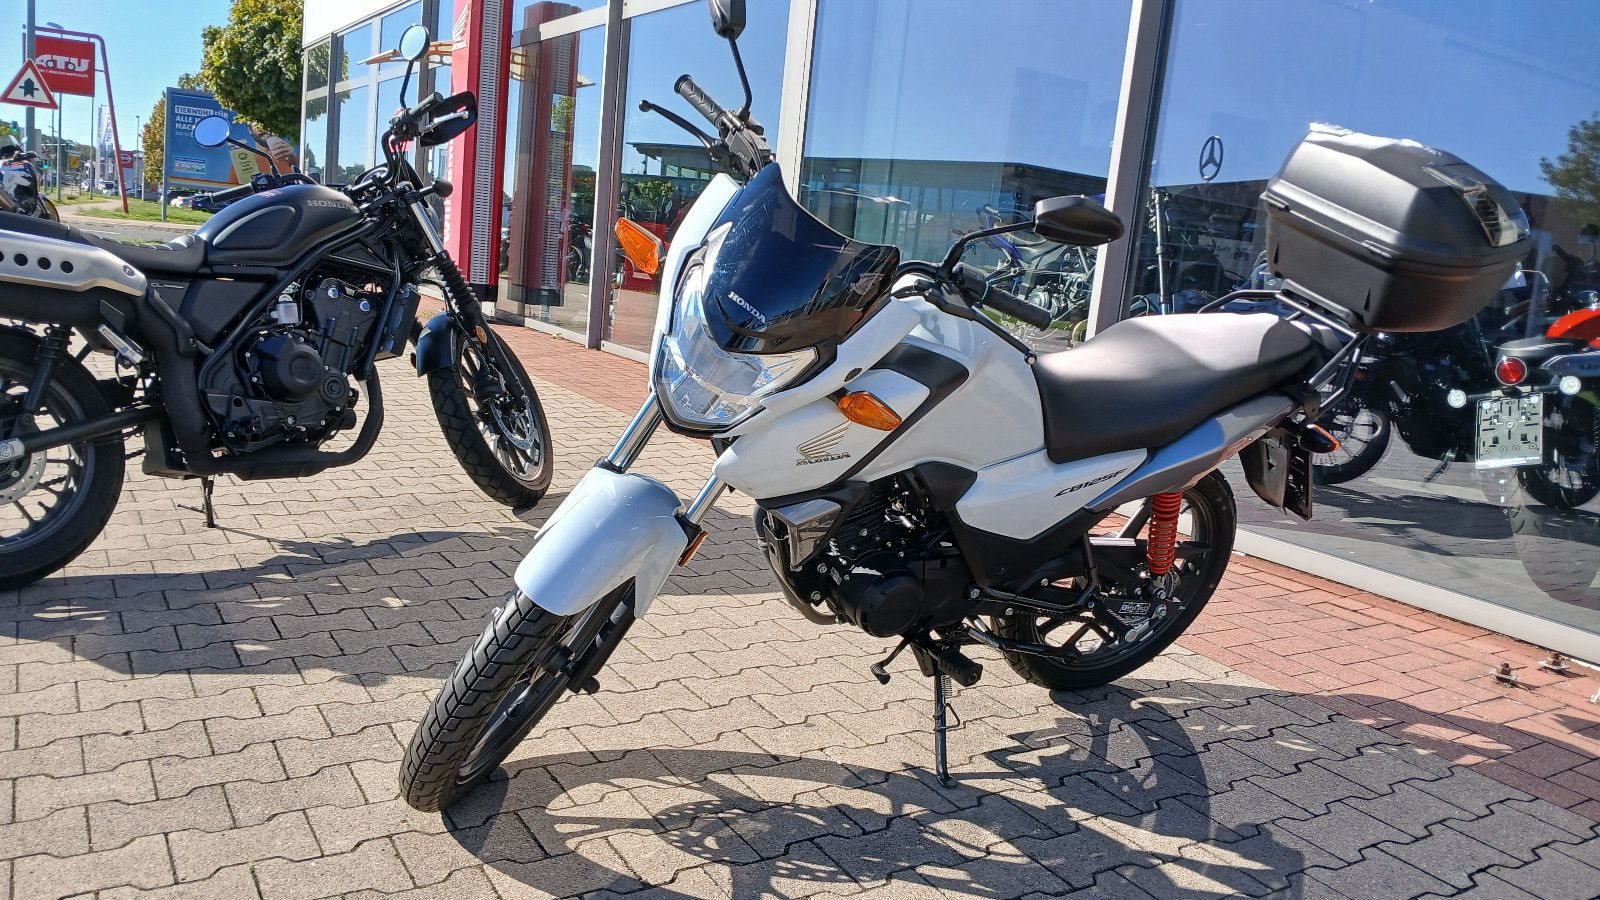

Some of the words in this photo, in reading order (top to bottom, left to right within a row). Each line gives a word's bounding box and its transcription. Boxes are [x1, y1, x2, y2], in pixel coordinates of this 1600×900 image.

[175, 115, 193, 123] ALLE
[176, 106, 213, 117] TIERWOHL
[728, 291, 766, 324] HONDA
[795, 451, 851, 466] HONDA
[1054, 467, 1128, 498] CB125F
